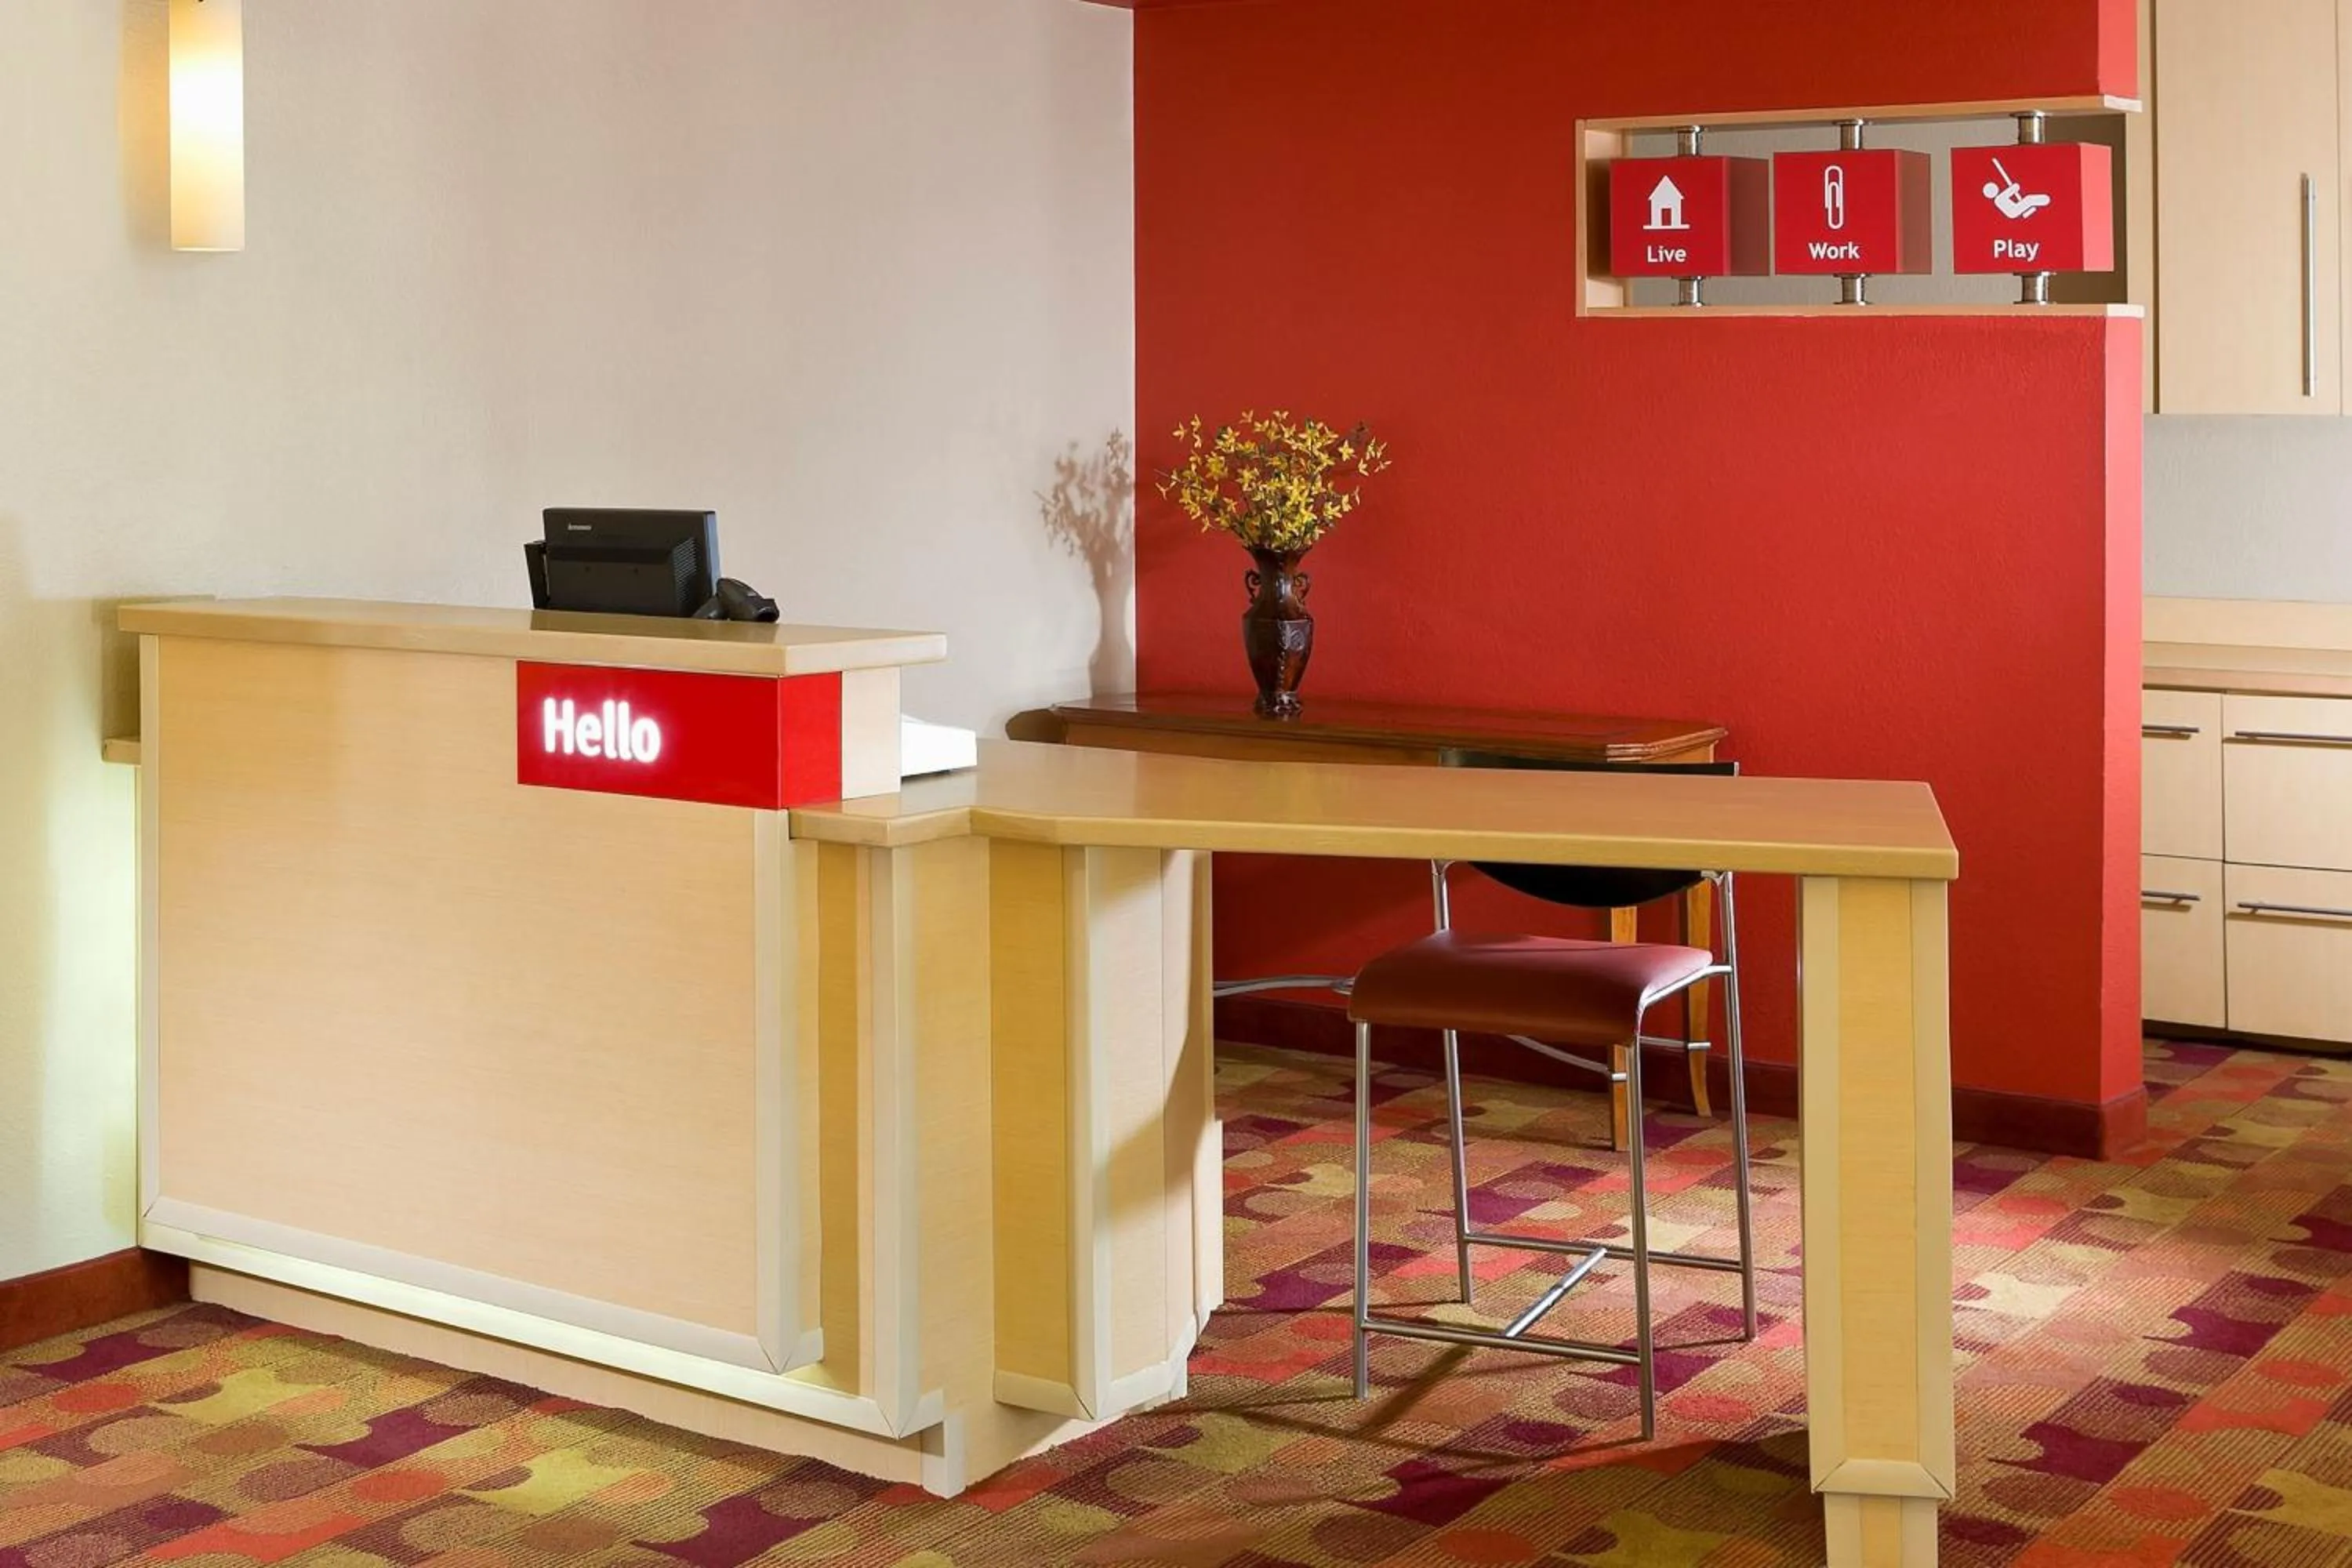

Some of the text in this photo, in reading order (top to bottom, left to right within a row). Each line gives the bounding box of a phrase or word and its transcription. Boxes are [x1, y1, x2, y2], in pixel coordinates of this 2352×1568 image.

[1647, 245, 1686, 263] Live
[1808, 241, 1860, 260] Work
[1994, 238, 2039, 262] Play
[542, 696, 662, 763] Hello
